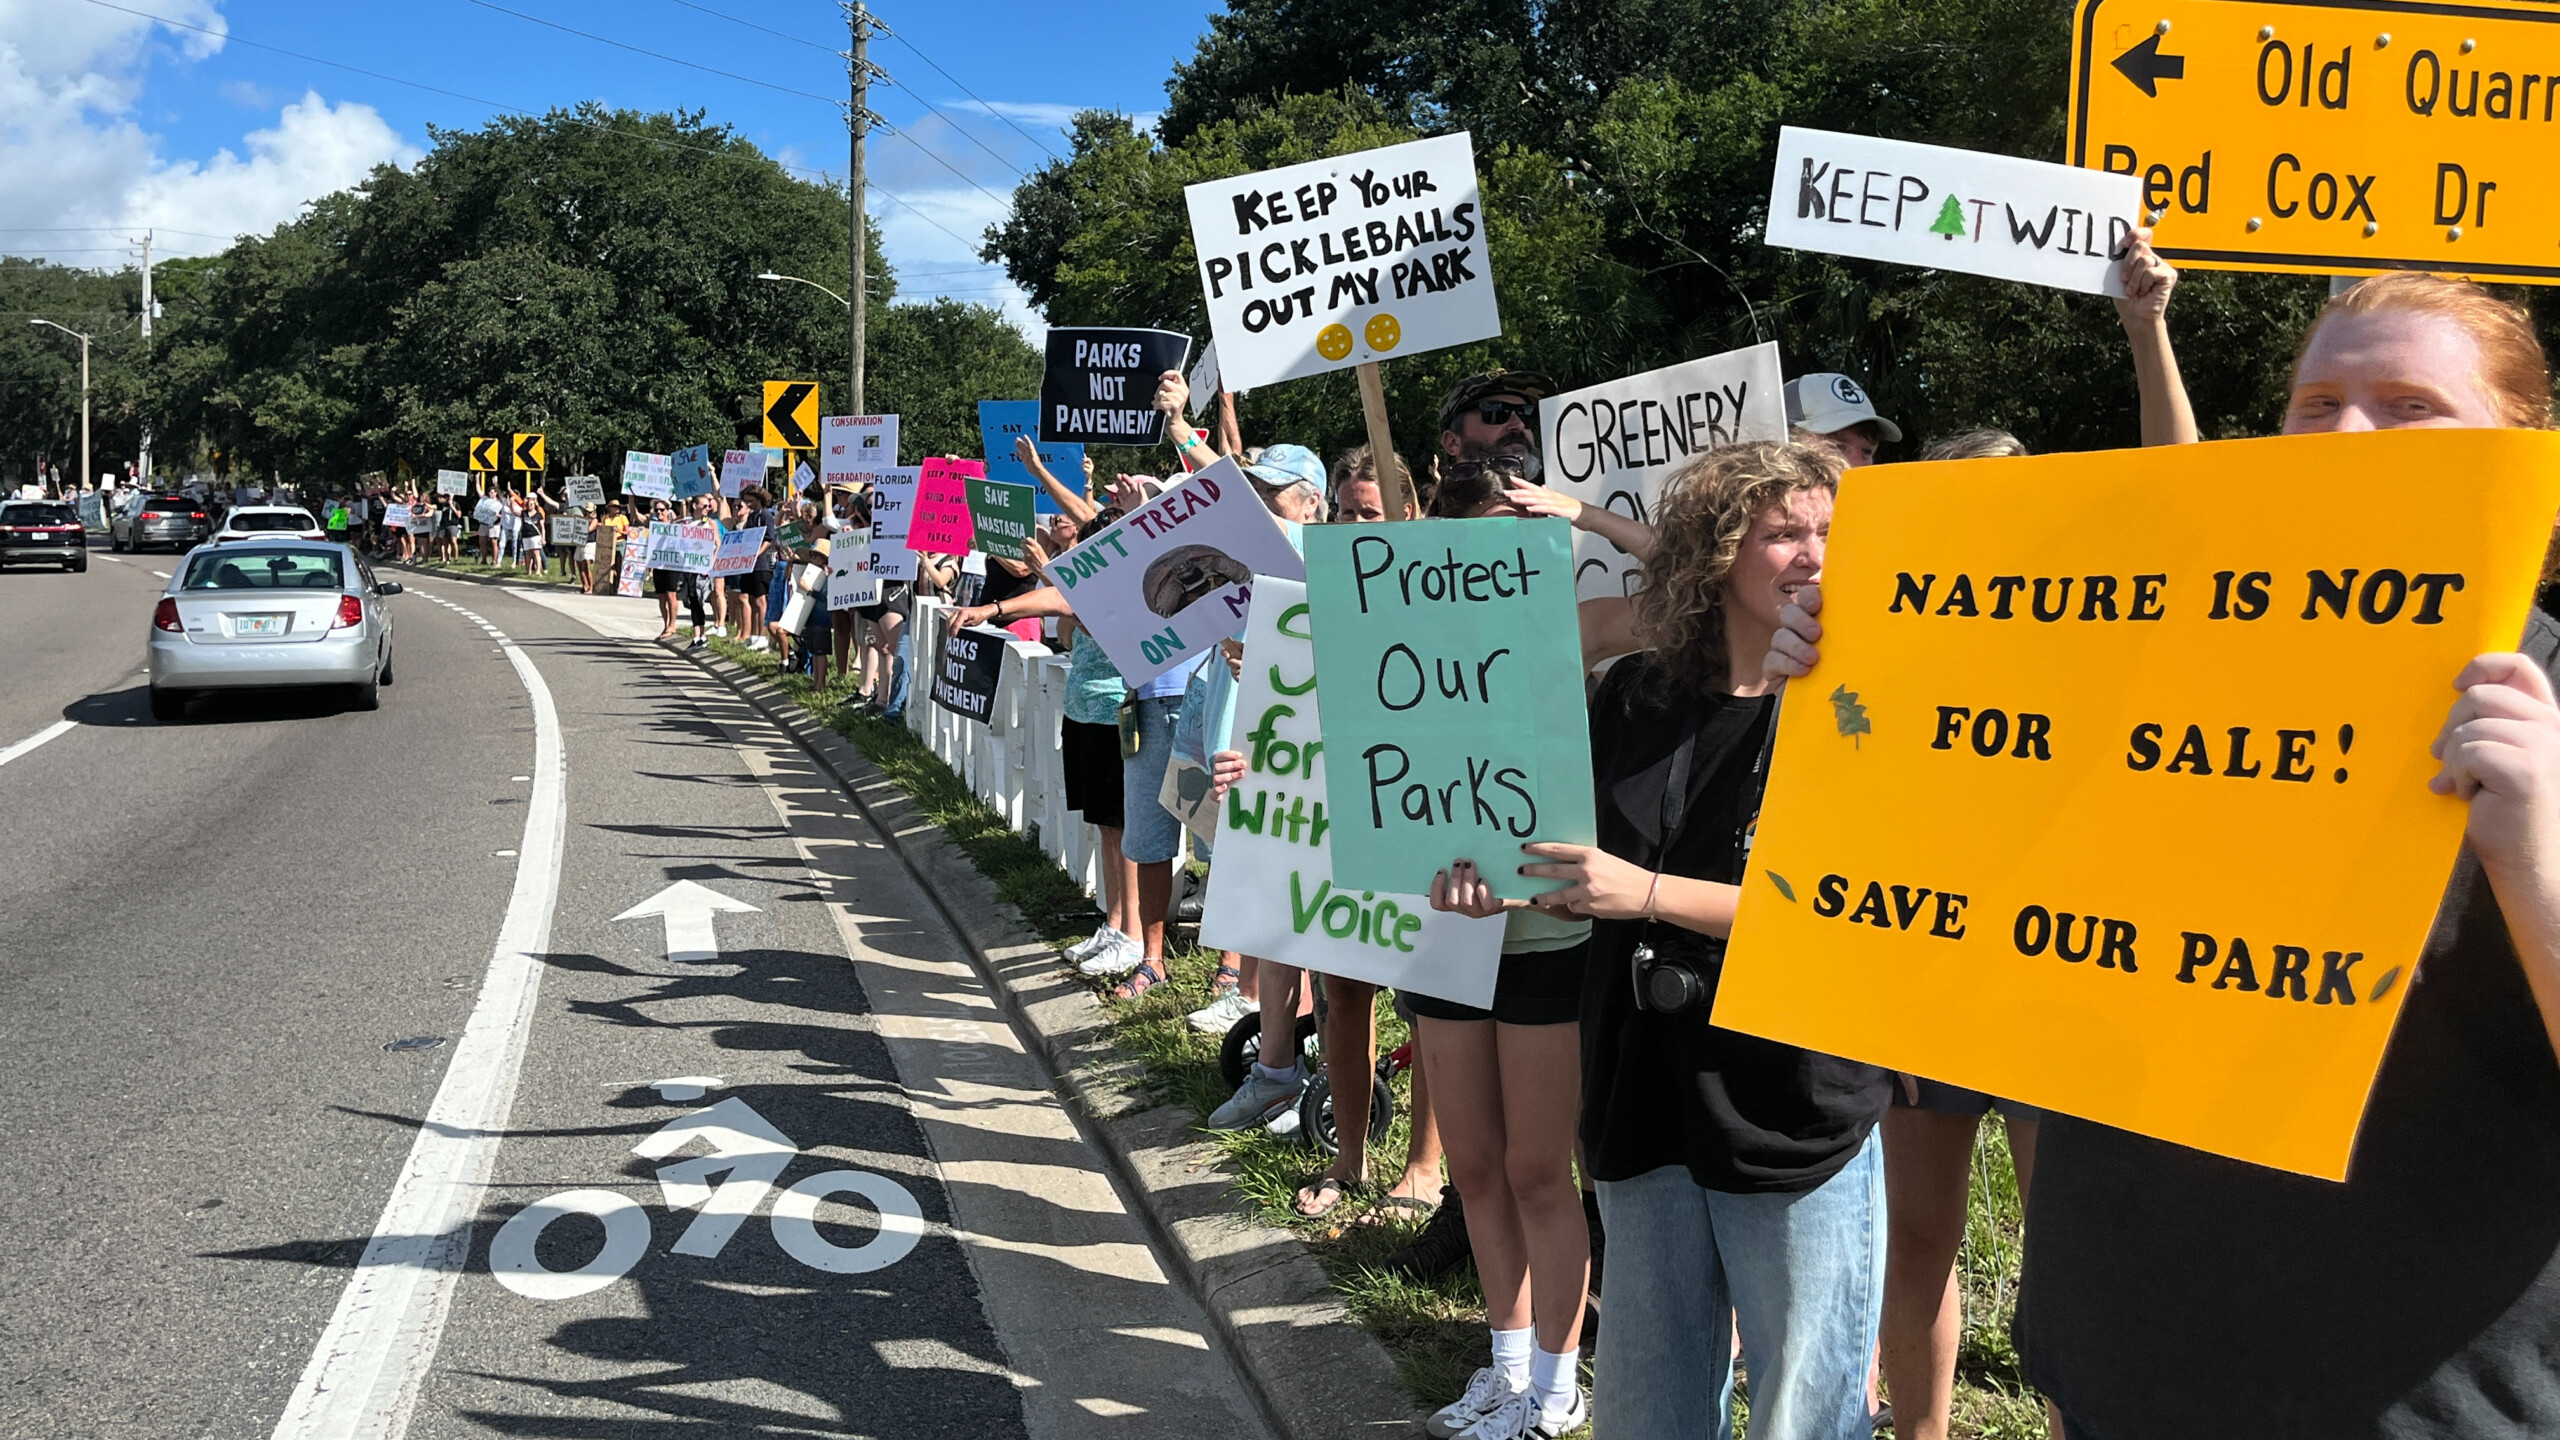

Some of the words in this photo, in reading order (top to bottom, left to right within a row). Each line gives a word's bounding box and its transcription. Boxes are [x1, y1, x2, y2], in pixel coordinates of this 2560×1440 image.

[2257, 40, 2352, 110] Old
[2267, 153, 2376, 222] Cox
[2434, 162, 2496, 228] Dr
[1232, 182, 1337, 235] KEEP
[1798, 157, 1929, 231] KEEP
[2006, 202, 2131, 261] WILD
[1205, 203, 1475, 299] PICKLEBALLS
[1242, 286, 1315, 333] OUT
[1328, 267, 1379, 310] MY
[1391, 246, 1476, 300] PARK
[1075, 339, 1141, 368] PARKS
[1089, 373, 1126, 401] NOT
[831, 416, 883, 428] CONSERVATION
[1002, 424, 1022, 433] SAY
[1056, 404, 1156, 435] PAVEMENT
[1556, 381, 1748, 482] GREENERY
[831, 445, 845, 455] NOT
[875, 475, 913, 485] FLORIDA
[949, 472, 969, 481] YOU
[874, 491, 902, 511] DEPT
[984, 486, 1010, 507] SAVE
[652, 523, 678, 537] PICKLE
[942, 514, 959, 524] OUR
[976, 513, 1026, 538] ANASTASIA
[928, 532, 952, 543] PARKS
[987, 540, 1007, 556] STATE
[1054, 528, 1129, 590] DON'T
[1129, 478, 1221, 540] TREAD
[652, 550, 679, 563] STATE
[684, 552, 710, 567] PARKS
[870, 552, 900, 575] PROFIT
[1352, 536, 1540, 613] Protect
[1888, 572, 2167, 623] NATURE
[2208, 570, 2271, 622] IS
[2300, 567, 2465, 627] NOT
[945, 637, 978, 661] ARKS
[1140, 626, 1187, 665] ON
[946, 656, 966, 683] NOT
[1378, 643, 1510, 711] Our
[935, 674, 987, 715] PAVEMENT
[1930, 706, 2052, 761] FOR
[2126, 723, 2356, 784] SALE!
[1289, 871, 1422, 953] Voice
[1813, 874, 1969, 941] SAVE
[2013, 904, 2139, 974] OUR
[2175, 931, 2364, 1006] PARK
